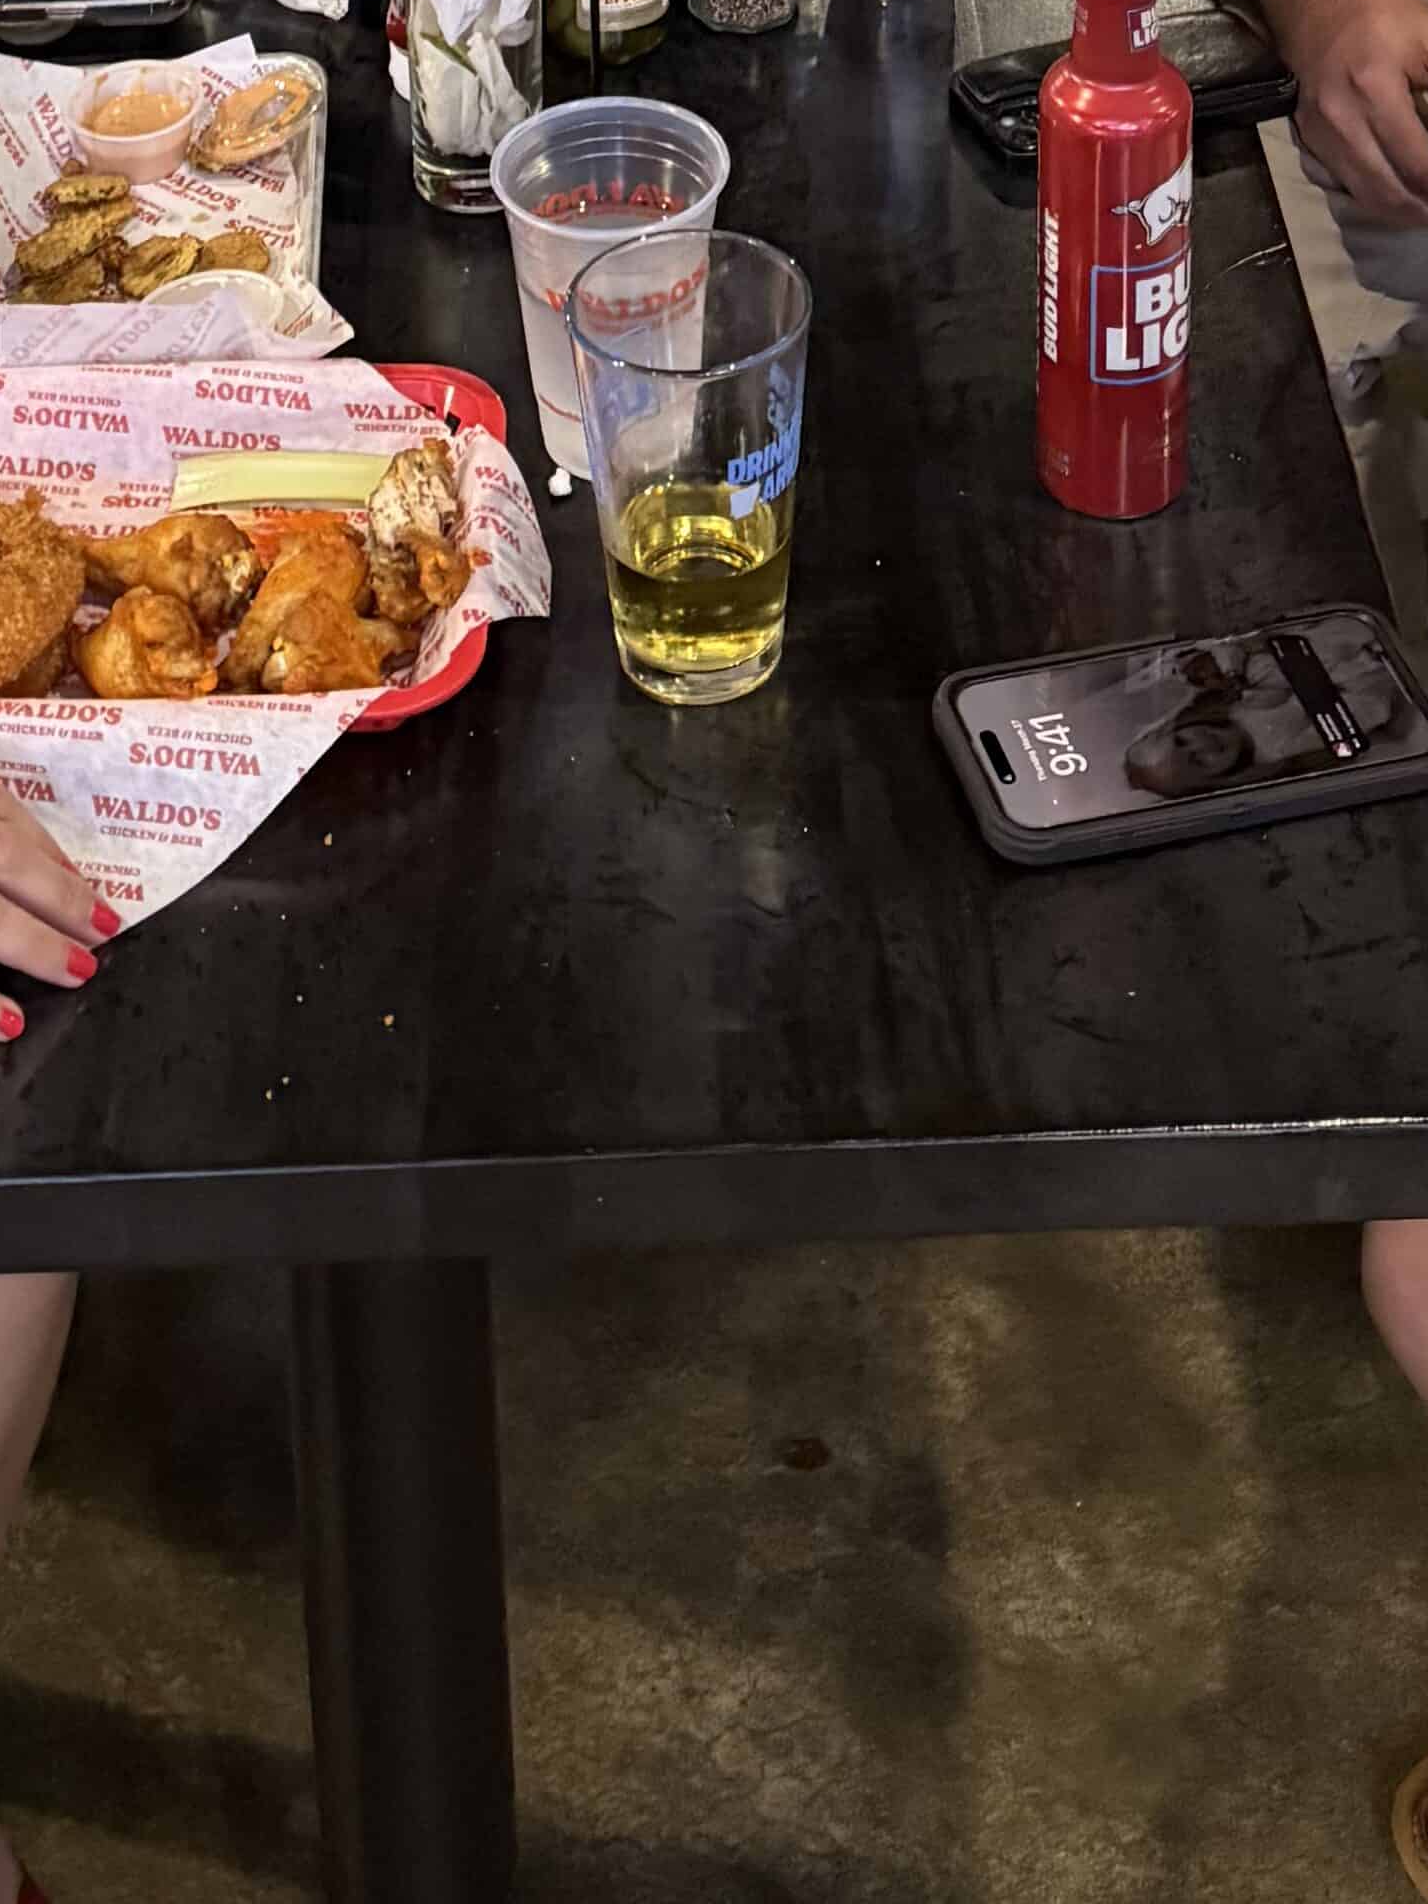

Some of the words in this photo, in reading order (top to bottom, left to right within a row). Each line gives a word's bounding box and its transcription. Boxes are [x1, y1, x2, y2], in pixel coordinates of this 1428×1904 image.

[35, 92, 74, 161] WALD
[1043, 207, 1059, 296] LIGHT
[1134, 247, 1192, 324] BU
[1043, 299, 1059, 363] BUD
[1105, 311, 1190, 372] LIG
[194, 378, 312, 411] WALDO'S
[12, 404, 131, 434] WALDO'S
[161, 425, 282, 452] WALDO'S
[194, 731, 253, 747] CHICKEN
[1028, 712, 1088, 776] 9:41
[128, 742, 262, 777] WALDO'S
[91, 794, 223, 832] WALDO'S
[99, 824, 157, 842] CHICKEN
[171, 833, 204, 848] BEER
